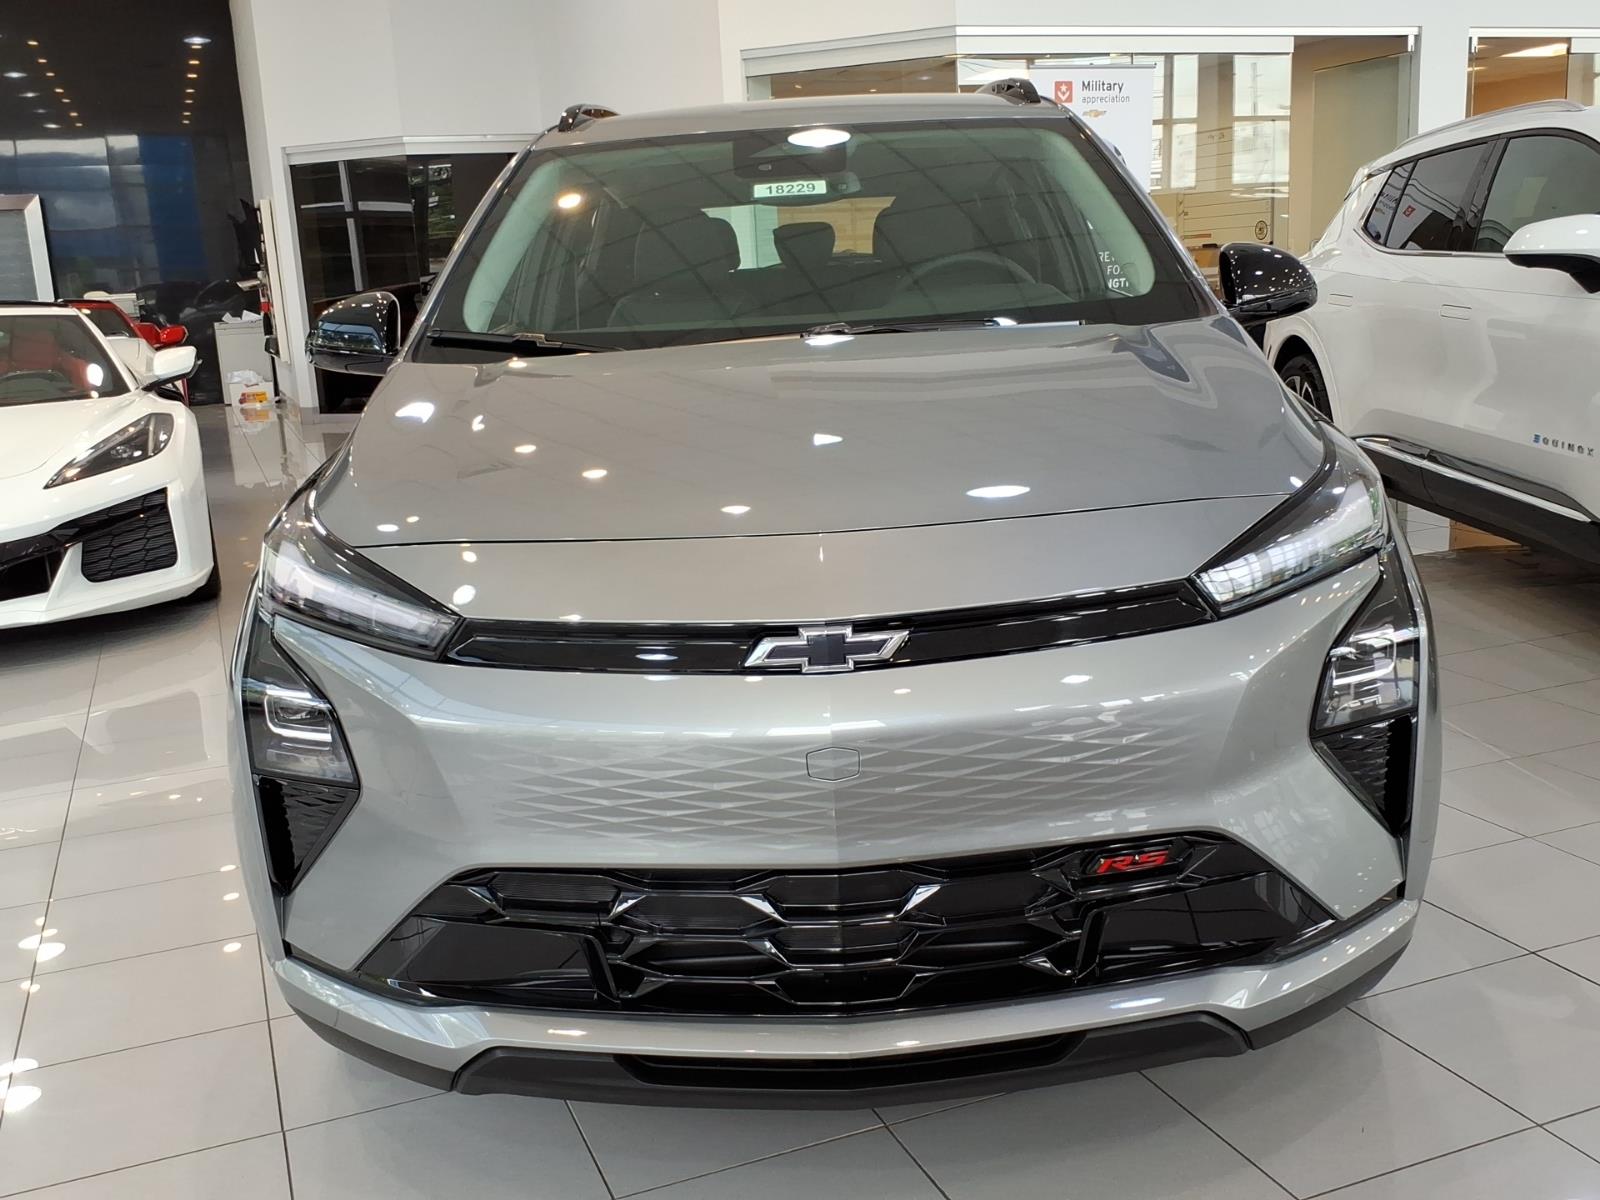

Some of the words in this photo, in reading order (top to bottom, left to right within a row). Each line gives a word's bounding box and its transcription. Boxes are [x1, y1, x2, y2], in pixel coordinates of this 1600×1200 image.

[1081, 80, 1124, 93] Military
[1081, 94, 1130, 105] appreciation
[765, 183, 816, 195] 18229
[1532, 433, 1595, 457] EQUINOX
[1096, 849, 1169, 874] RS
